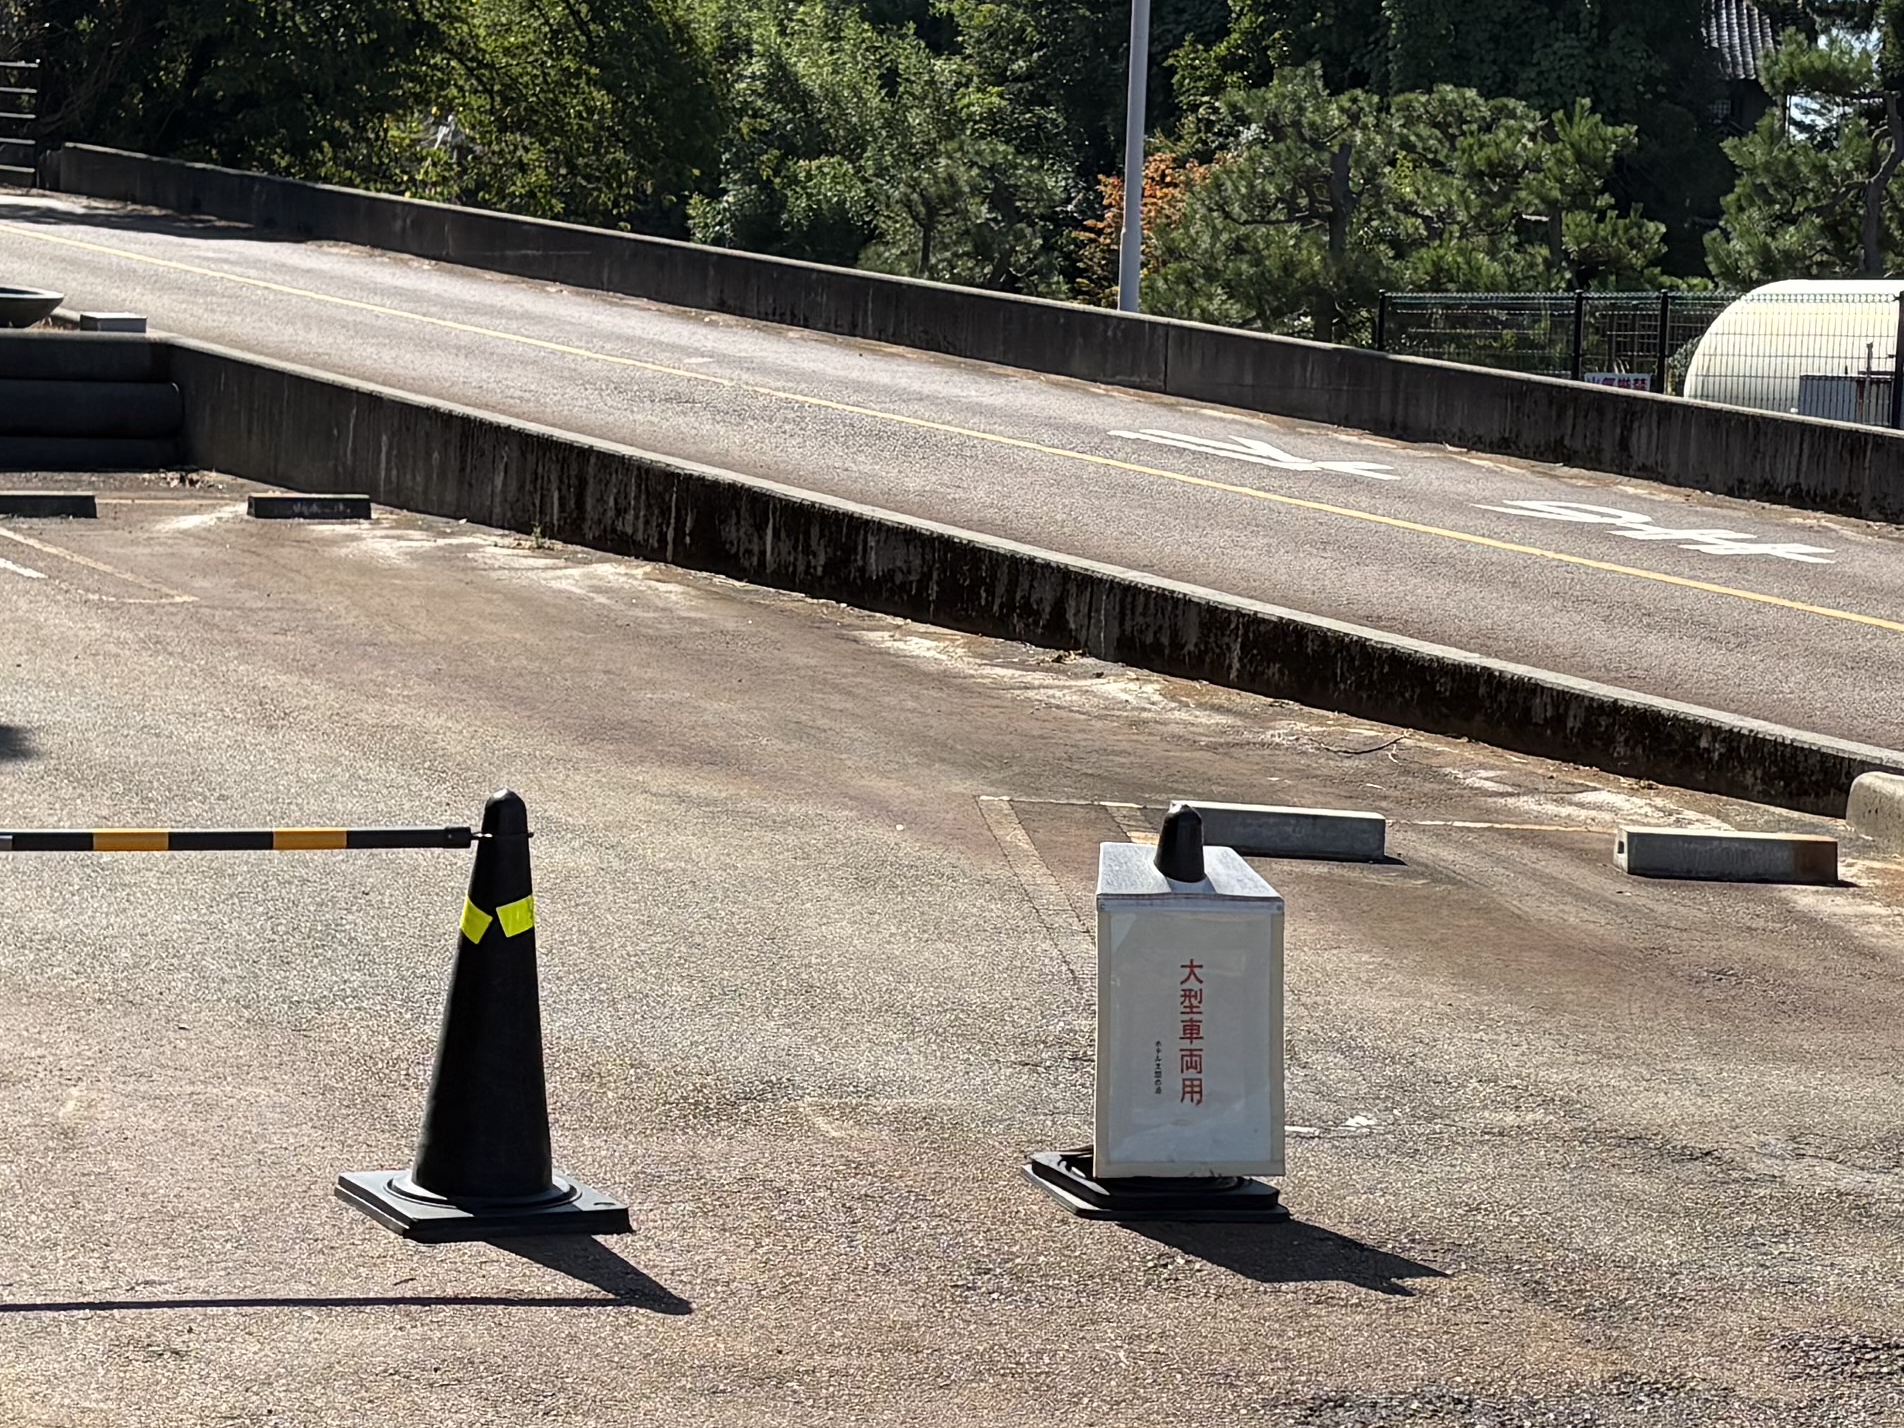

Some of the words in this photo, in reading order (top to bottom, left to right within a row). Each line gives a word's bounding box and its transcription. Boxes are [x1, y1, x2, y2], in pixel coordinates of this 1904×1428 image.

[1179, 958, 1204, 1107] 大型車両用
